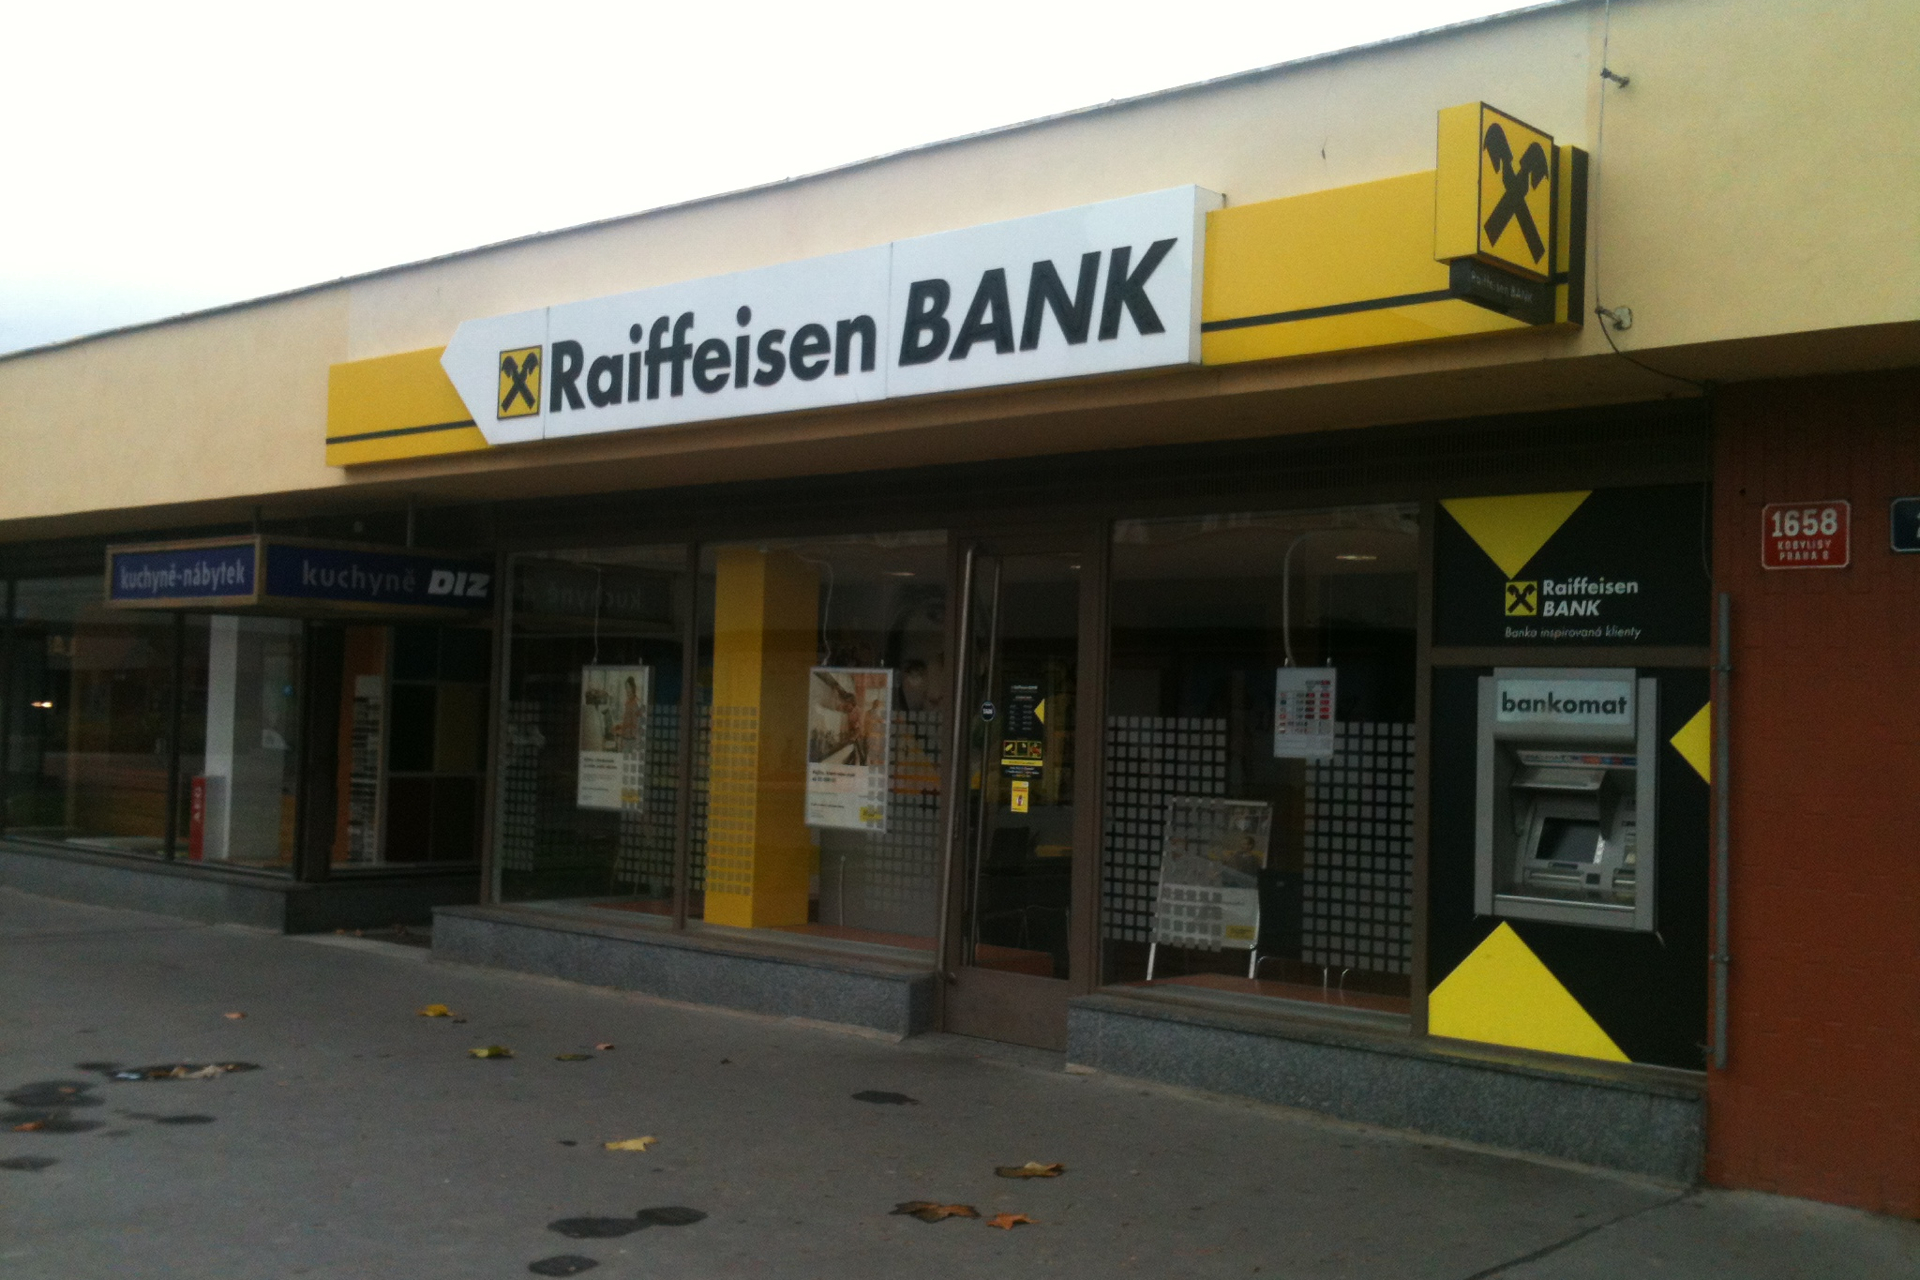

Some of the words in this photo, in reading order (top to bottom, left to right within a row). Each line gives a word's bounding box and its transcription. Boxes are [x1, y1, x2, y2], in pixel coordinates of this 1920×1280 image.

[549, 304, 878, 413] Raiffeisen
[898, 237, 1179, 367] BANK
[1771, 508, 1838, 538] 1658
[1779, 551, 1818, 561] PRAHA
[302, 558, 416, 596] kuchyně
[427, 569, 491, 598] DIZ
[1542, 576, 1639, 596] Raiffeisen
[1542, 599, 1602, 617] BANK
[1505, 626, 1538, 638] Banka
[1605, 625, 1642, 640] klienty
[1501, 690, 1627, 715] bankomat
